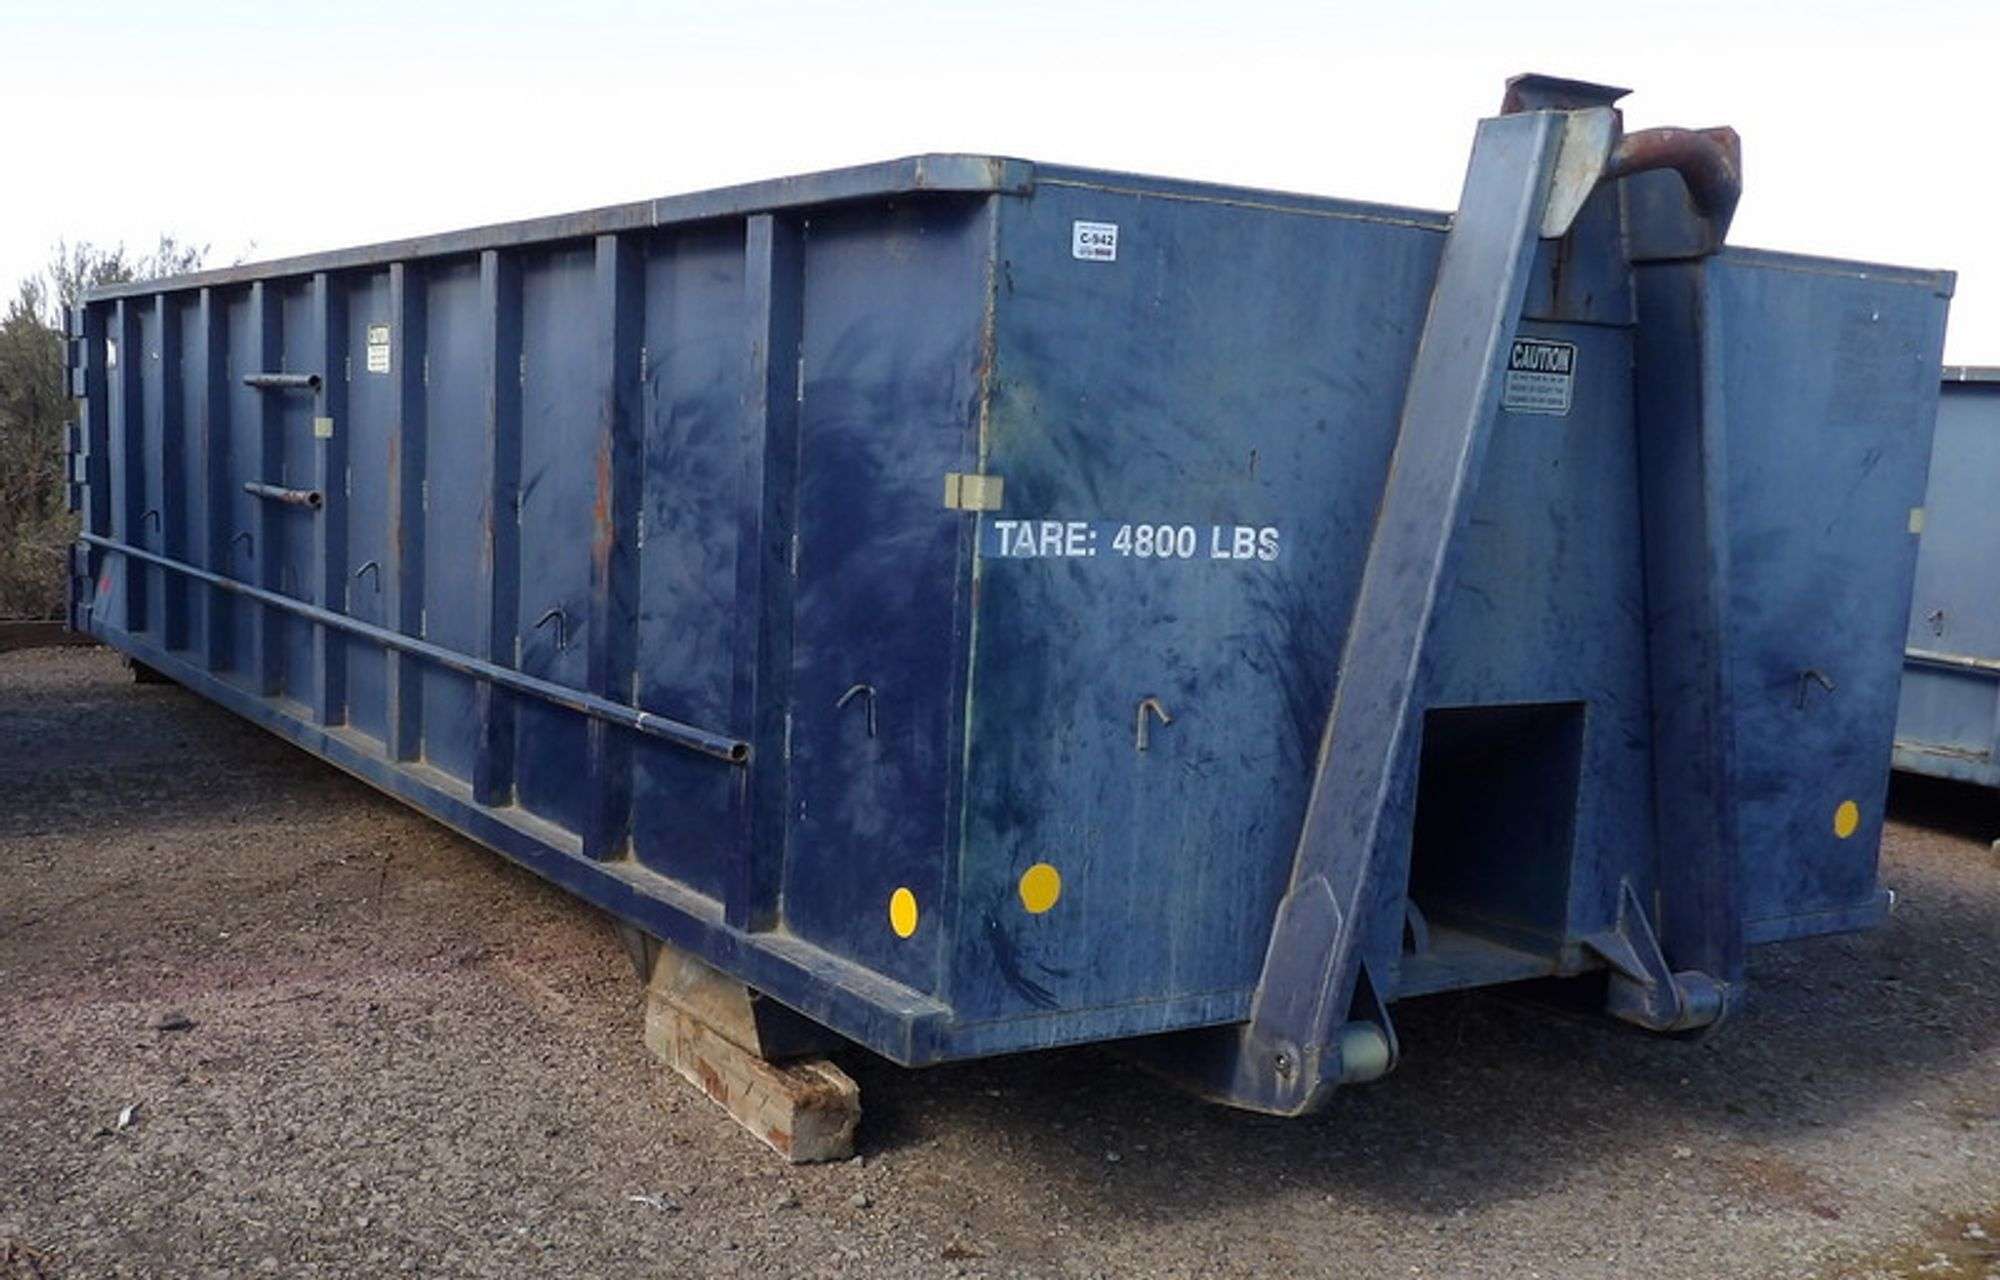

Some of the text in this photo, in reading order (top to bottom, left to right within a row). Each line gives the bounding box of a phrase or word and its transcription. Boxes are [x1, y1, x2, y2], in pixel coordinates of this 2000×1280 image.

[1512, 344, 1570, 372] CAUTION
[995, 521, 1280, 561] TARE: 4800 LBS
